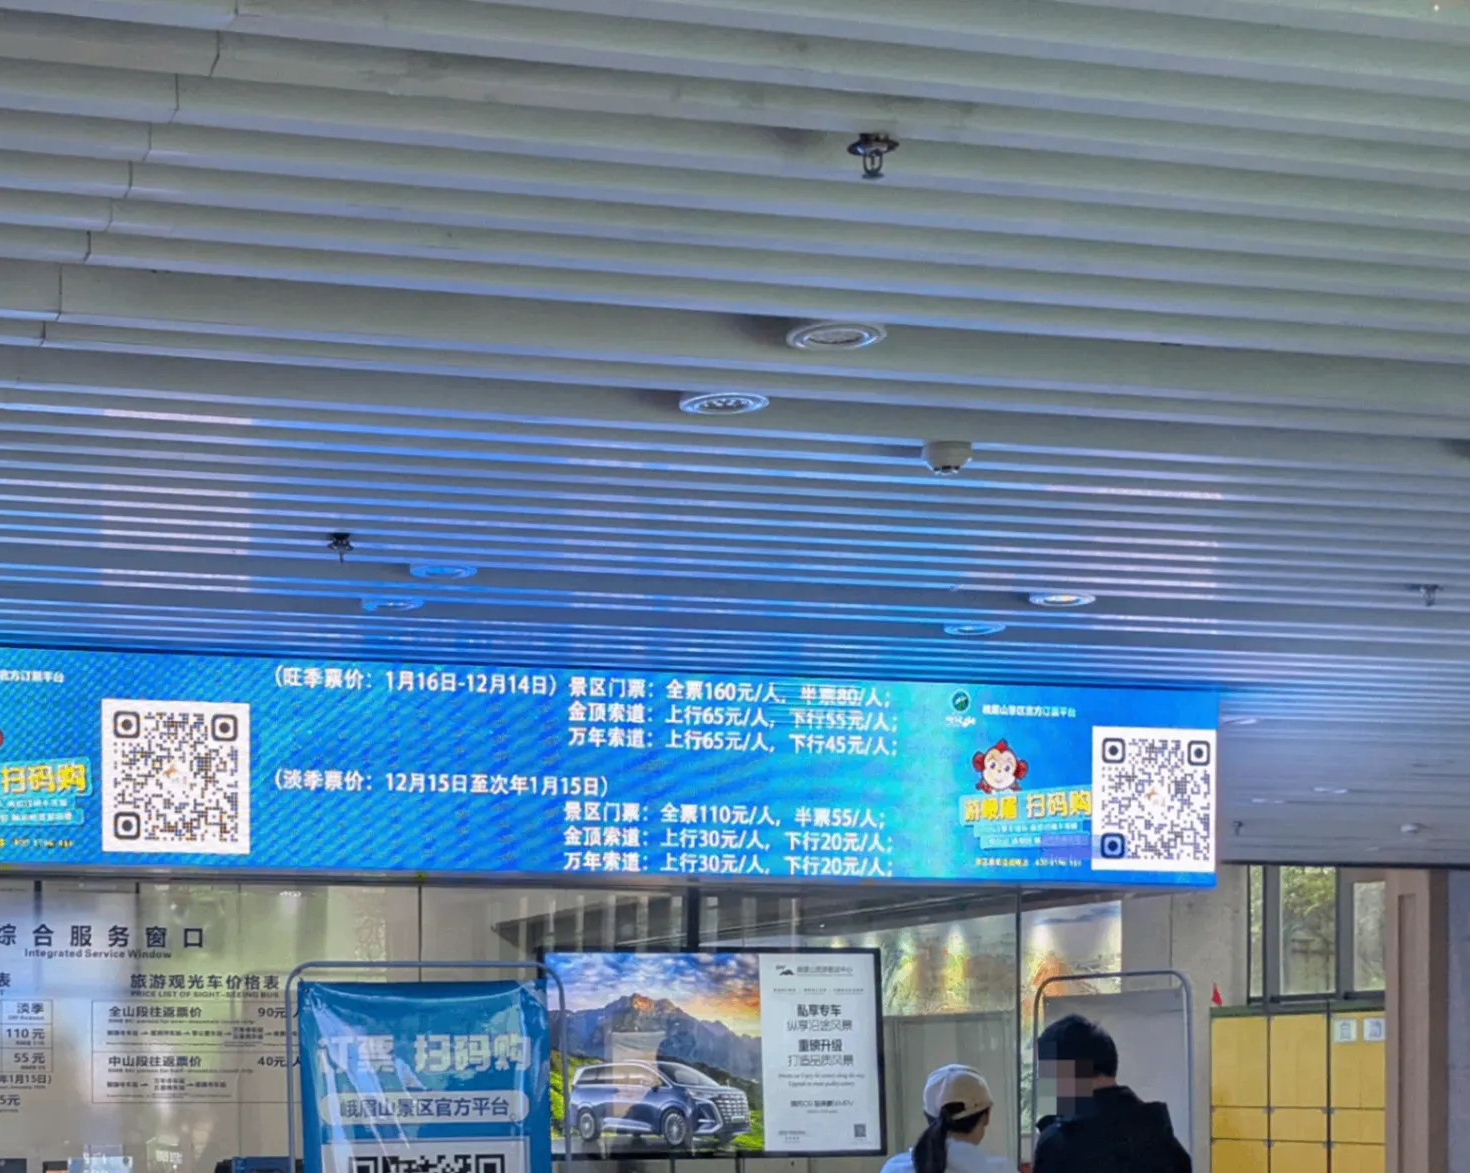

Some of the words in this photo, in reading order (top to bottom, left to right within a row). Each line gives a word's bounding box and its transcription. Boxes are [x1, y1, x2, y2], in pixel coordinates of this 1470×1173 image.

[25, 948, 82, 960] Integrated
[85, 949, 124, 959] Service
[128, 949, 172, 959] Window
[130, 974, 279, 990] 旅游观光车价格表
[130, 990, 156, 998] PRICE
[158, 990, 177, 998] LIST
[179, 990, 191, 998] OF
[260, 991, 279, 999] BUS
[17, 1003, 44, 1014] 淡季
[109, 1006, 202, 1018] 全山段往返票价
[414, 1032, 532, 1072] 扫码购
[109, 1056, 202, 1067] 中山段往返票价
[340, 1097, 510, 1117] 峨眉山景区官方平台
